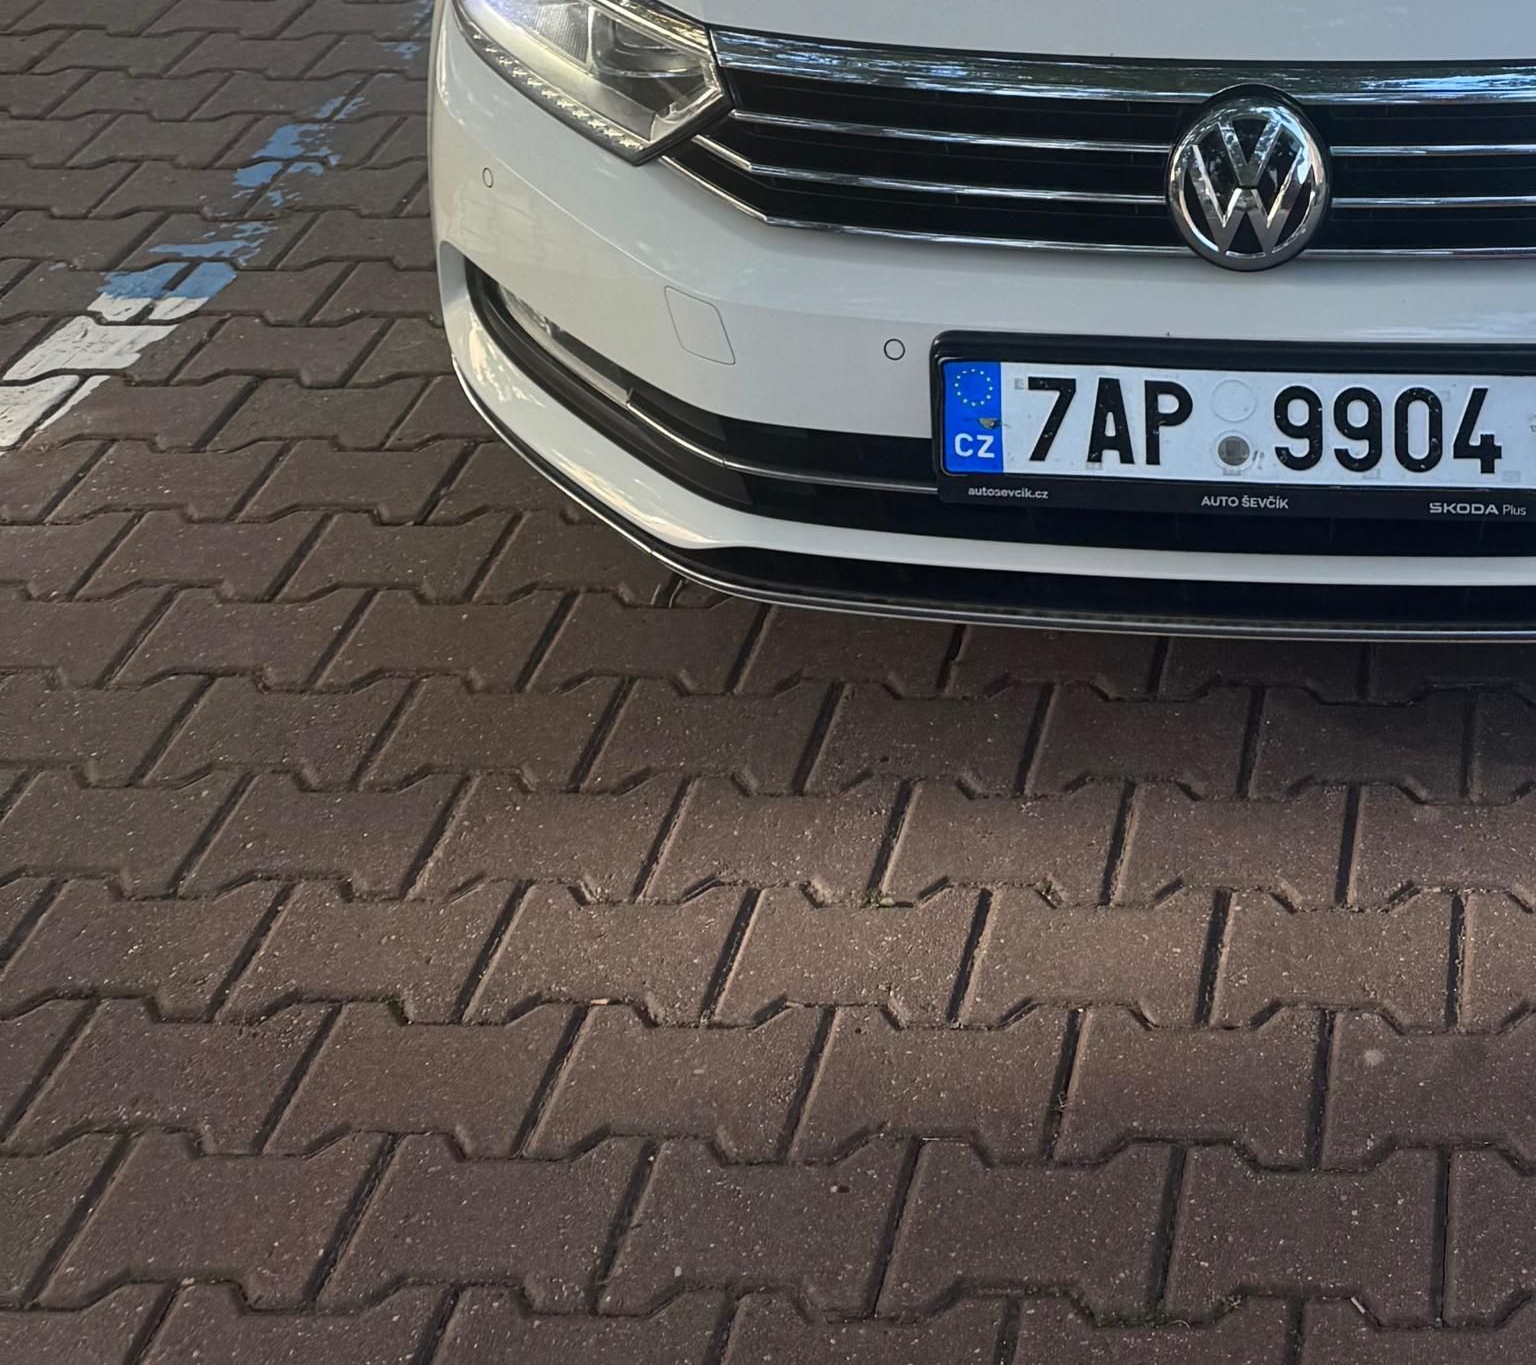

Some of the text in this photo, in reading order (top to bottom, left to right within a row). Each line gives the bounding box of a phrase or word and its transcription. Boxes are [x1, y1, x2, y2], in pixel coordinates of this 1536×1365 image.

[1027, 376, 1503, 474] 7AP 9904
[954, 432, 996, 459] CZ
[1201, 494, 1289, 510] AUTO ŠEVČÍK
[1502, 504, 1527, 516] Plus
